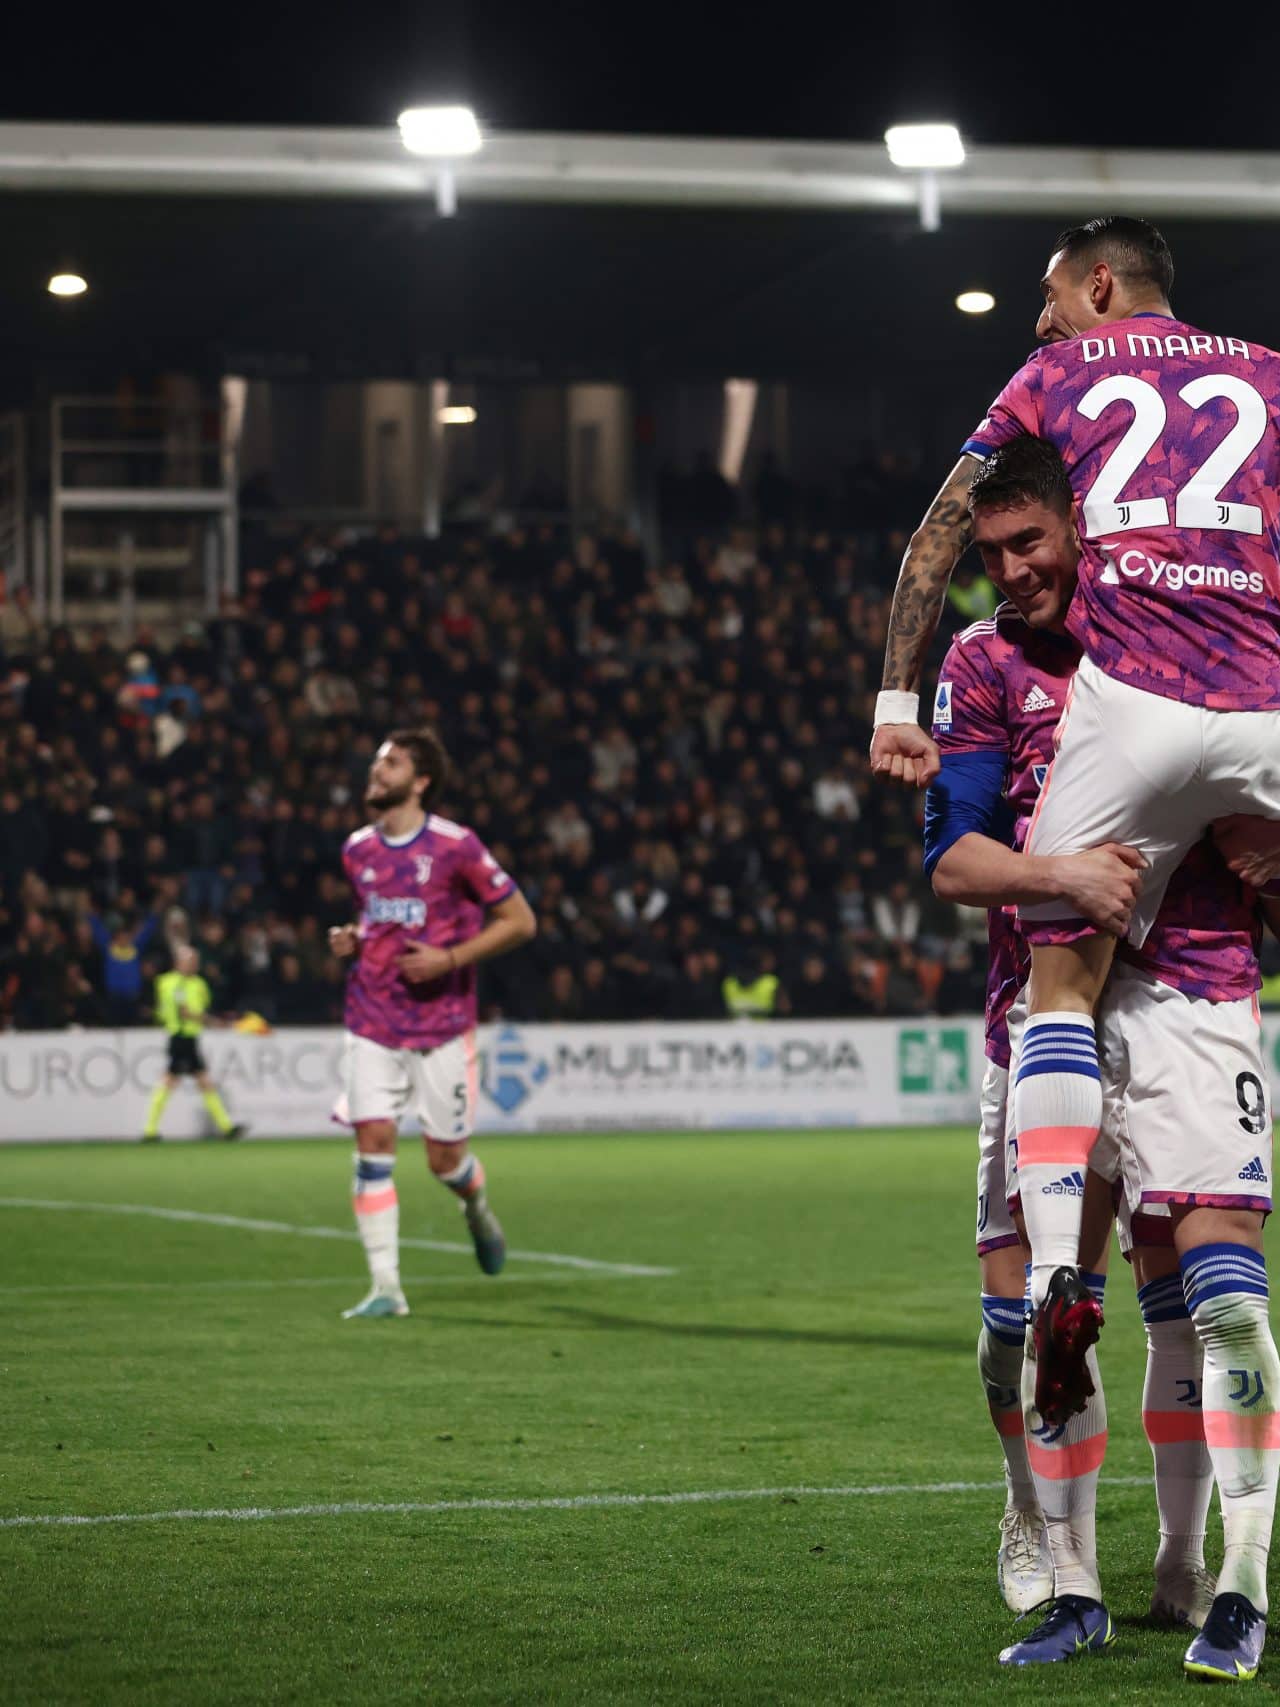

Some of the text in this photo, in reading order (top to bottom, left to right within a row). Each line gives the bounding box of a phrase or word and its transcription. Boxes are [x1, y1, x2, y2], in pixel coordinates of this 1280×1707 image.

[1081, 333, 1250, 363] DI MARIA
[1076, 374, 1268, 539] 22
[1119, 550, 1264, 594] Cygames
[1022, 698, 1056, 713] adidas
[1236, 1071, 1266, 1135] 9
[1238, 1170, 1268, 1184] adidas
